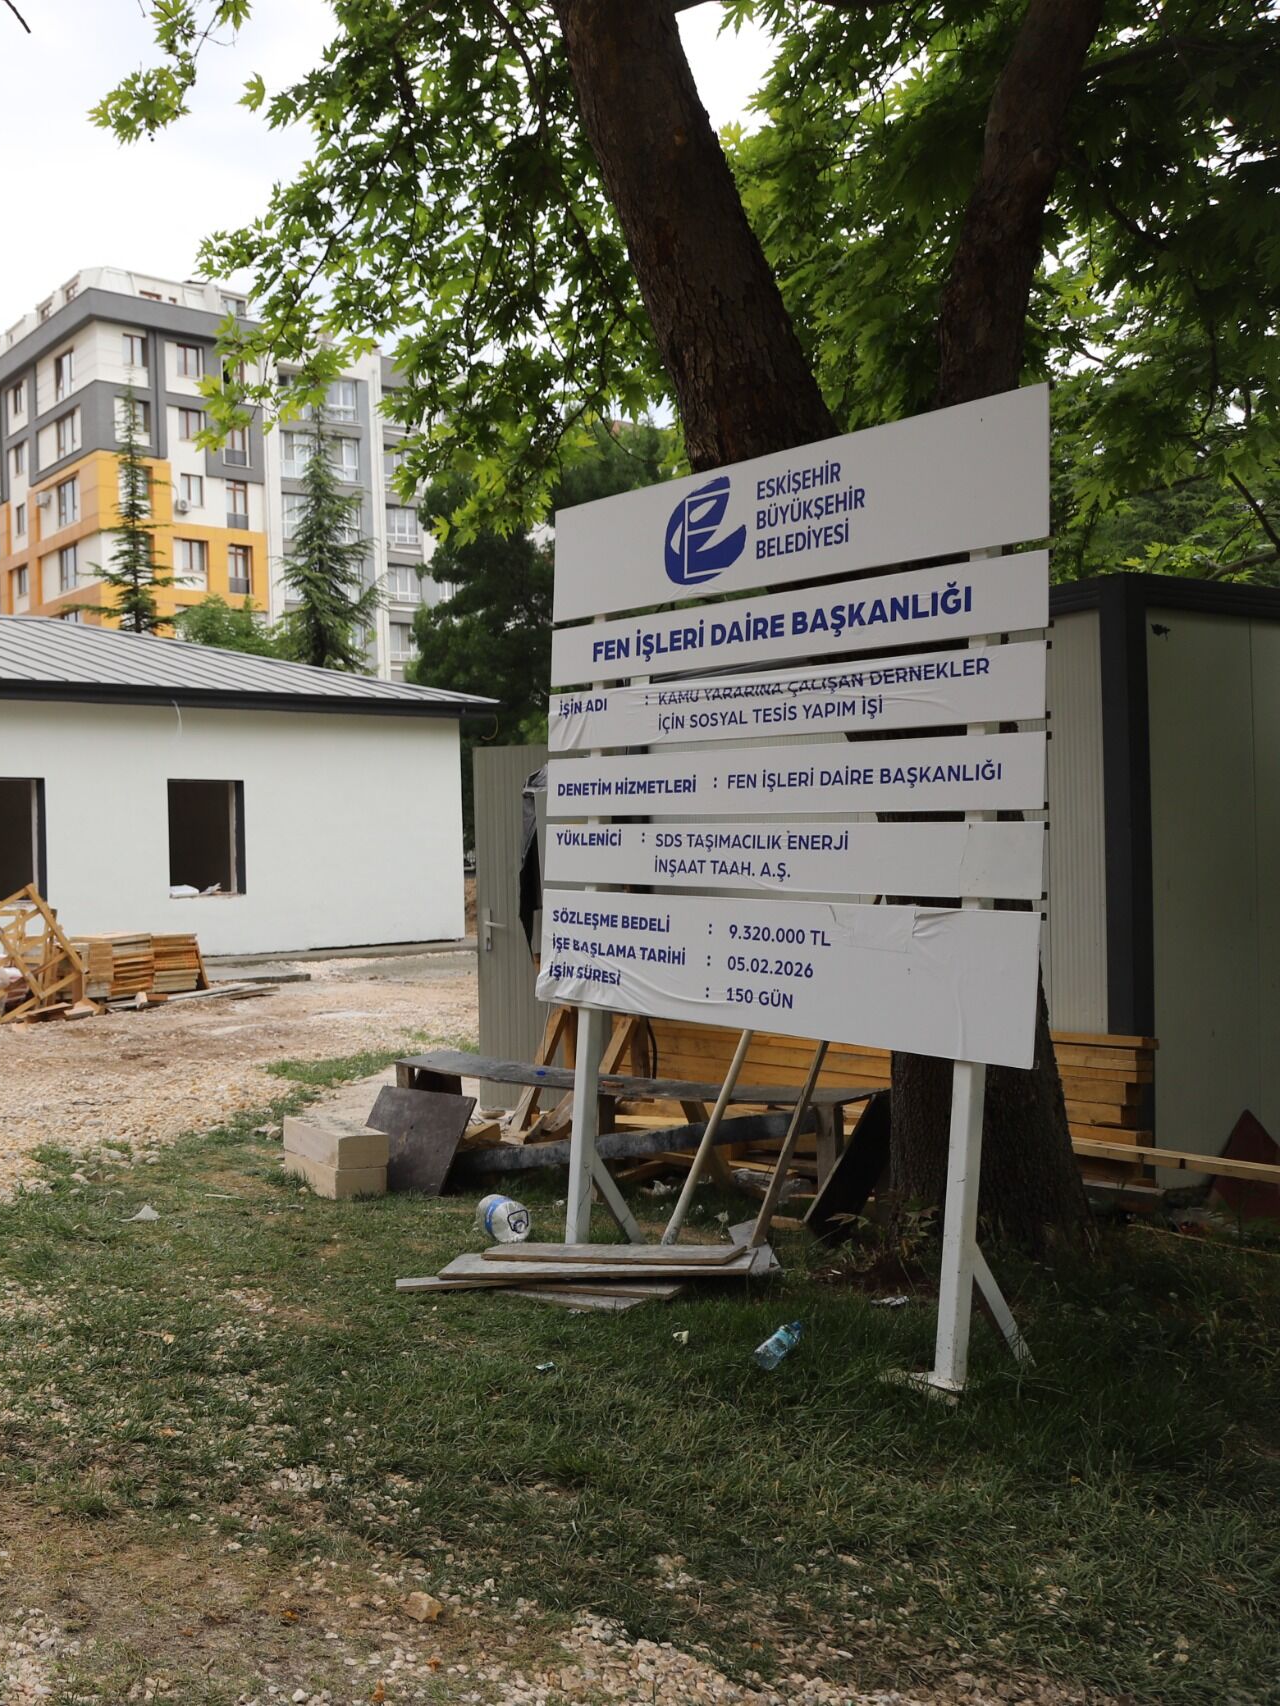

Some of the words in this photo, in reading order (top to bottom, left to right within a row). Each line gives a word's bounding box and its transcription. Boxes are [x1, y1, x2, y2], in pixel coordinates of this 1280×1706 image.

[757, 460, 841, 500] ESKİŞEHİR
[756, 485, 865, 530] BÜYÜKŞEHİR
[756, 518, 848, 560] BELEDİYESİ
[593, 637, 630, 662] FEN
[636, 619, 704, 662] İŞLERİ
[711, 612, 784, 646] DAİRE
[792, 581, 972, 637] BAŞKANLIĞI
[559, 698, 582, 719] İŞİN
[585, 698, 607, 712] ADI
[658, 690, 700, 706] KAMU
[704, 682, 783, 701] YARARINA
[787, 673, 864, 697] ÇALIŞAN
[869, 658, 990, 686] DERNEKLER
[659, 712, 684, 734] İÇİN
[690, 710, 748, 728] SOSYAL
[752, 702, 797, 723] TESİS
[802, 700, 855, 719] YAPIM
[861, 694, 882, 719] İŞİ
[558, 778, 612, 796] DENETİM
[615, 774, 696, 795] HİZMETLERİ
[728, 774, 757, 789] FEN
[763, 767, 814, 792] İŞLERİ
[820, 765, 873, 786] DAİRE
[880, 759, 1001, 788] BAŞKANLIĞI
[557, 829, 621, 846] YÜKLENİCİ
[656, 833, 682, 847] SDS
[687, 834, 781, 852] TAŞIMACILIK
[787, 830, 848, 850] ENERJİ
[655, 855, 706, 877] İNŞAAT
[710, 860, 756, 877] TAAH.
[760, 862, 790, 882] A.Ş.
[553, 907, 618, 930] SÖZLEŞME
[621, 915, 670, 933] BEDELİ
[729, 924, 805, 944] 9.320.000
[810, 930, 831, 946] TL
[553, 933, 570, 953] İŞE
[573, 939, 636, 959] BAŞLAMA
[640, 946, 685, 965] TARİHİ
[728, 956, 813, 978] 05.02.2026
[549, 962, 574, 981] İŞİN
[576, 964, 621, 986] SÜRESİ
[727, 987, 753, 1003] 150
[759, 989, 793, 1009] GÜN
